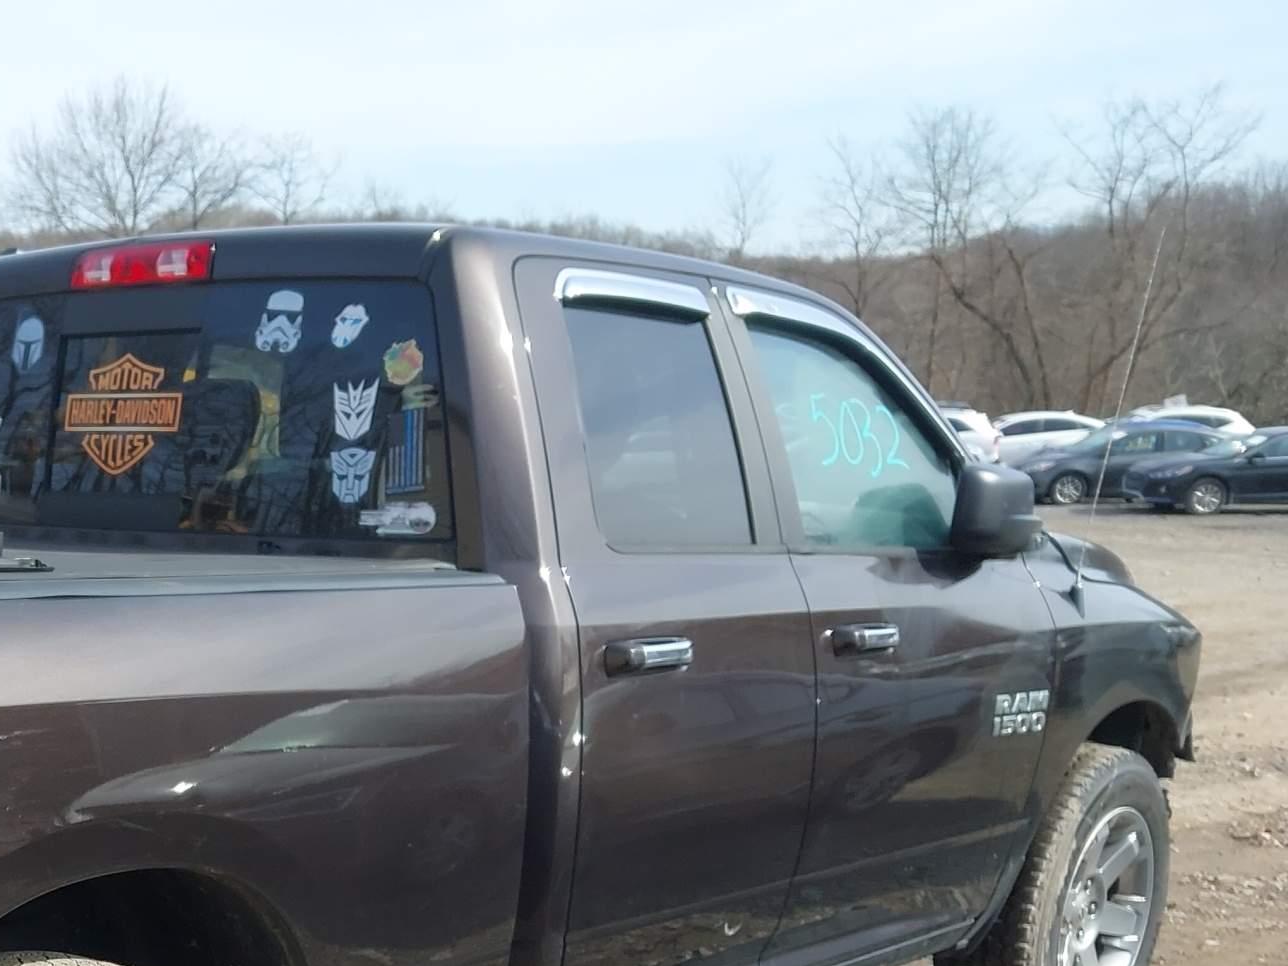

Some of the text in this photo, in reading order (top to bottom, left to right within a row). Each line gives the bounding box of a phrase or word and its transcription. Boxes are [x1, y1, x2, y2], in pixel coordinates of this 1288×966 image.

[98, 361, 153, 391] MOTOR
[71, 399, 176, 424] HARLEY-DAVIDSON
[809, 393, 910, 478] 5032
[90, 434, 145, 467] CYCLES
[995, 690, 1049, 715] RAM
[993, 711, 1046, 737] 1500
